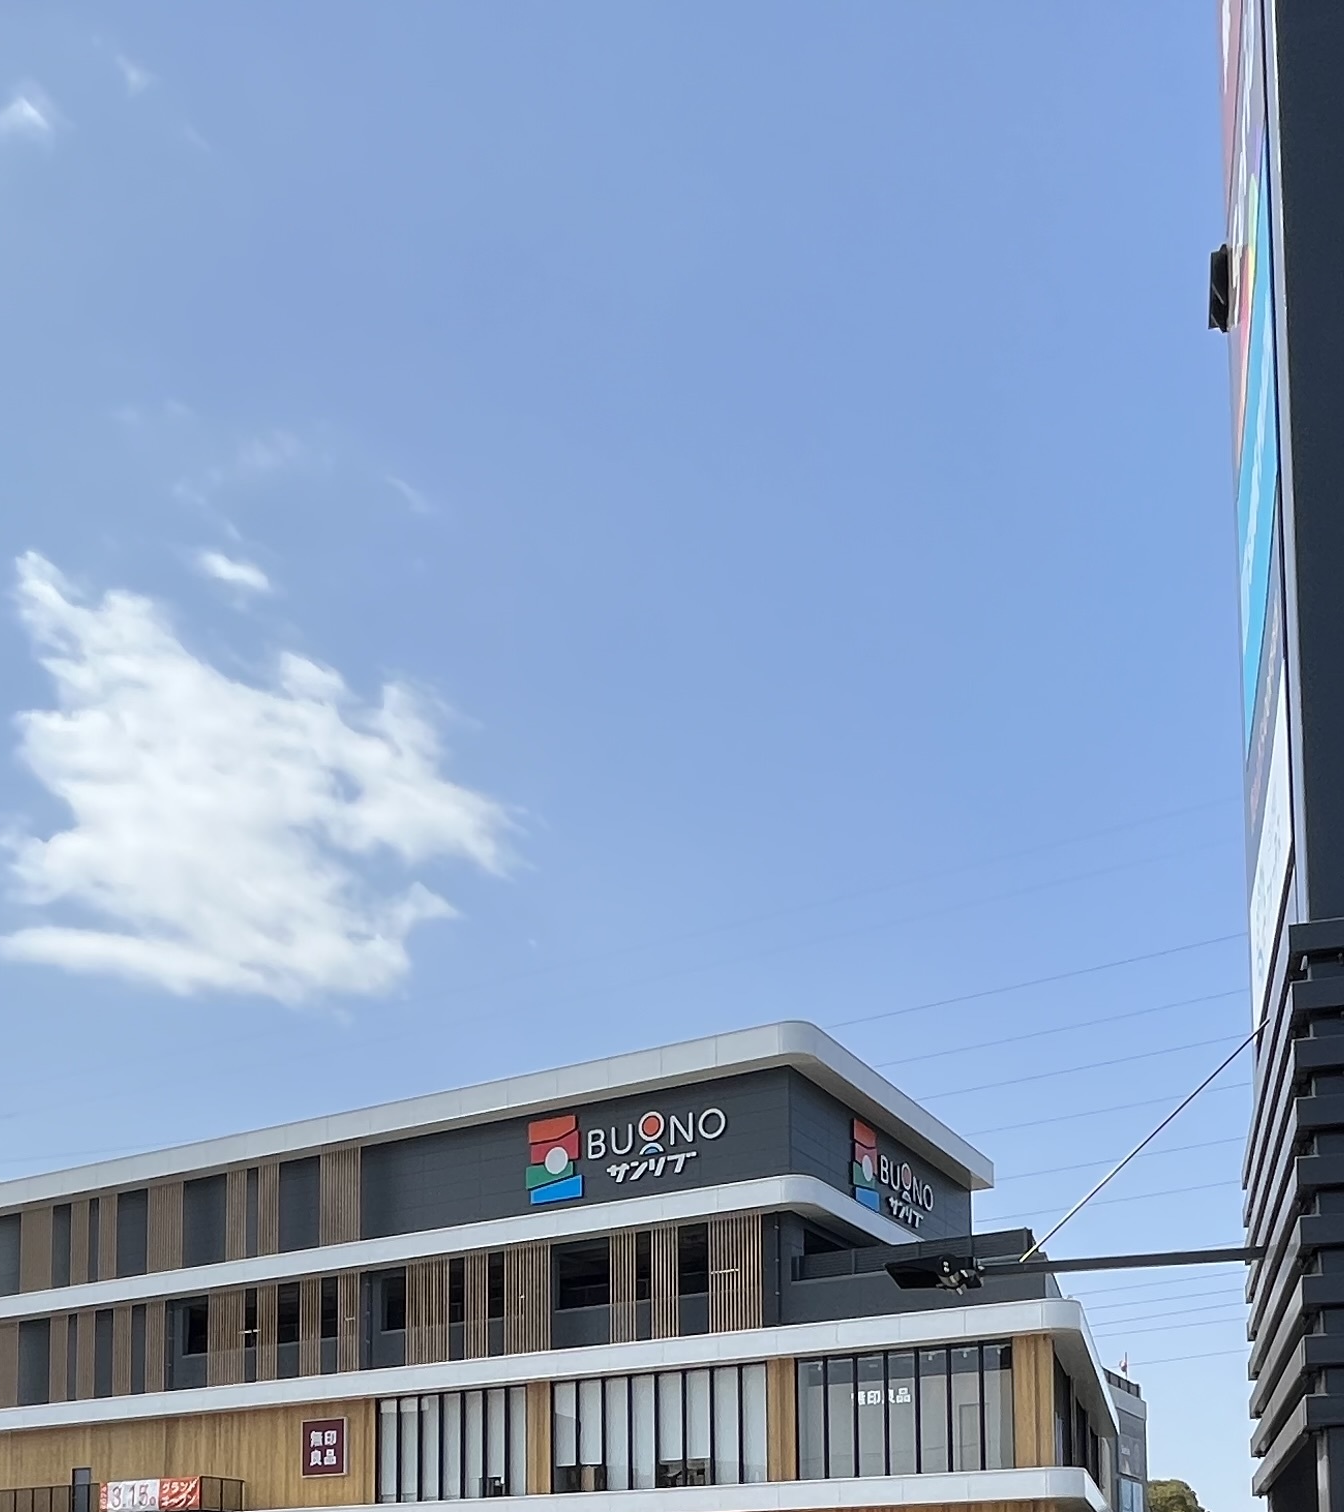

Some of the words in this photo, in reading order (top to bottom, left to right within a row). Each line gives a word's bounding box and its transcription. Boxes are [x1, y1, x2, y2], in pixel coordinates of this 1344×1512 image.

[587, 1107, 727, 1160] BUONO
[606, 1151, 698, 1184] サンリブ
[880, 1154, 934, 1212] BUONO
